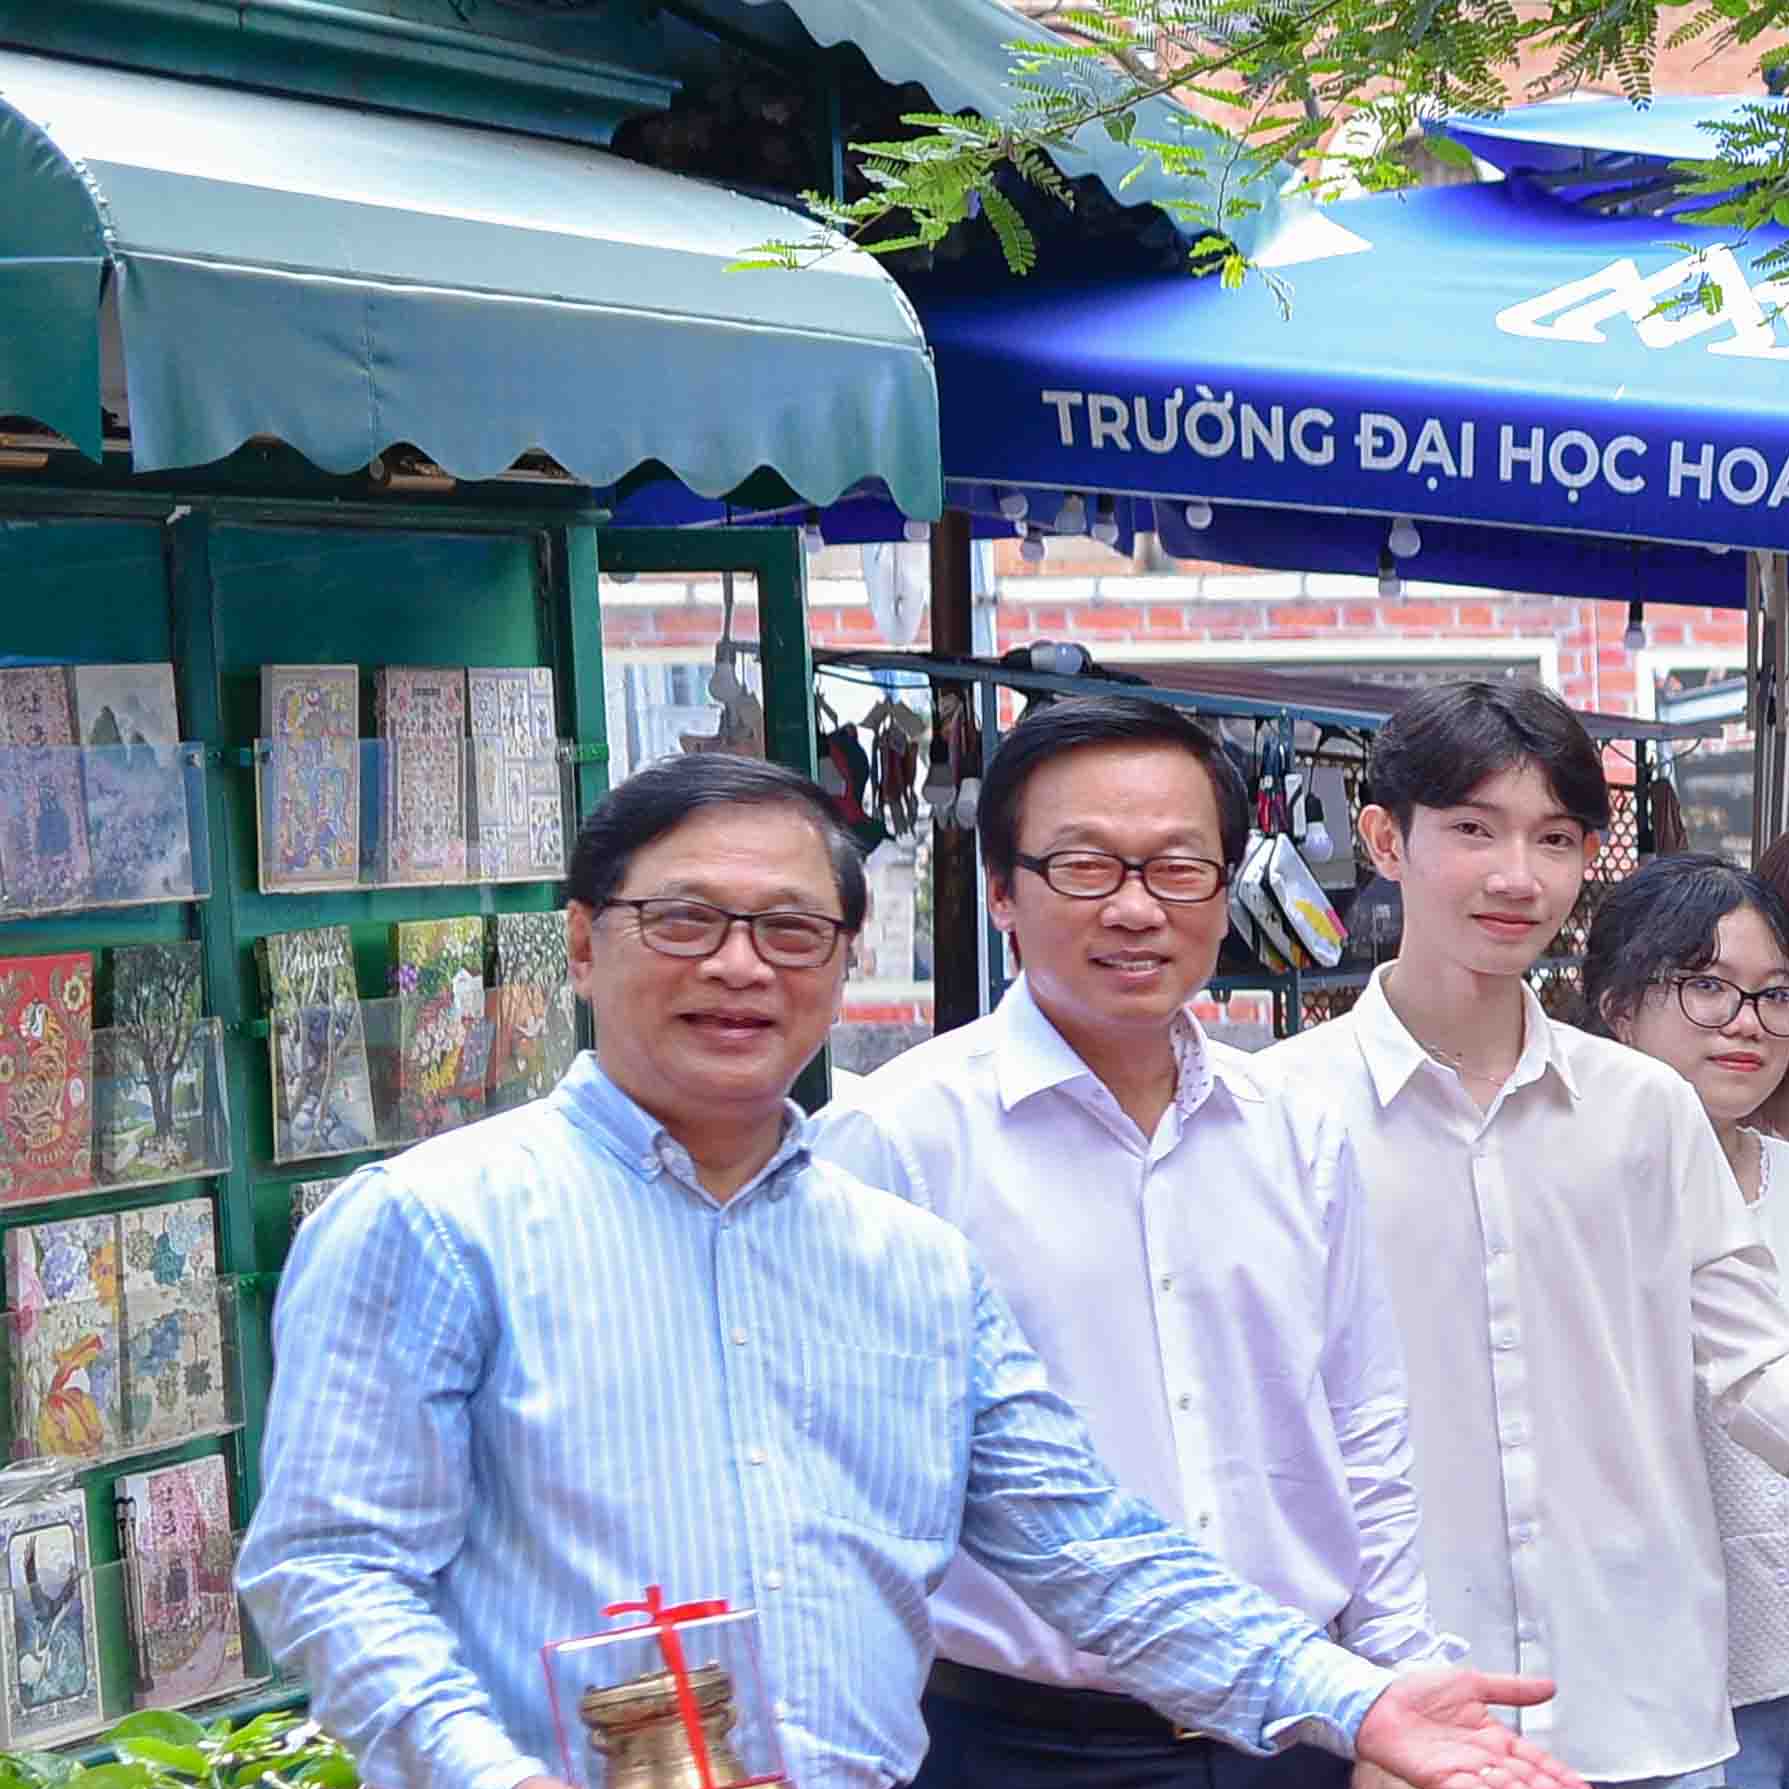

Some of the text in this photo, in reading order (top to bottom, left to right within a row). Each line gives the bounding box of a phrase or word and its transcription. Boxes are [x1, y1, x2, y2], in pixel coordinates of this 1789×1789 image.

[1042, 384, 1335, 467] TRƯỜNG
[1354, 411, 1474, 491] ĐẠI
[1499, 424, 1647, 503] HỌC
